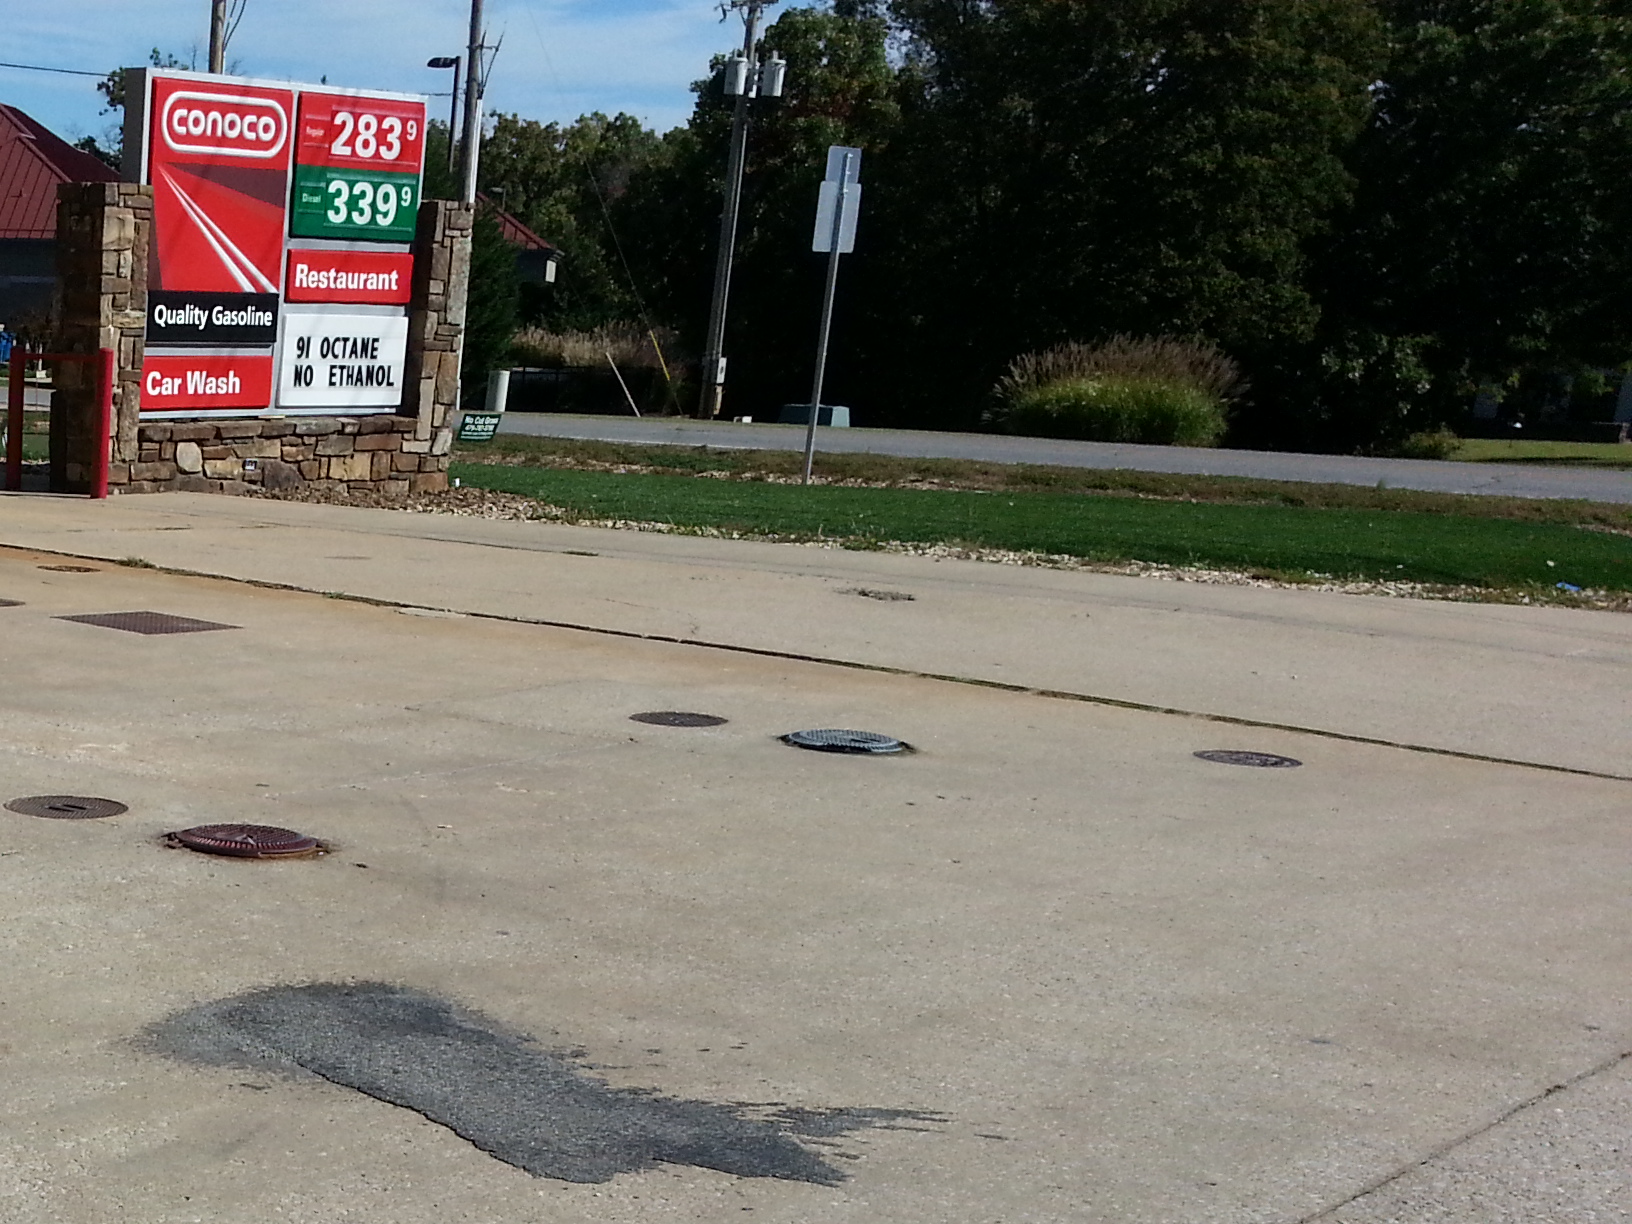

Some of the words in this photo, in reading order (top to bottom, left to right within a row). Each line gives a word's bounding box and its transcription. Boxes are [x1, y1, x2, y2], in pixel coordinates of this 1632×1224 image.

[295, 263, 399, 291] Restaurant
[154, 304, 209, 330] Quality
[212, 305, 273, 326] Gasoline
[320, 336, 380, 359] OCTANE
[146, 370, 183, 396] Car
[186, 370, 241, 395] Wash
[293, 364, 314, 387] NO
[328, 364, 395, 387] ETHANOL
